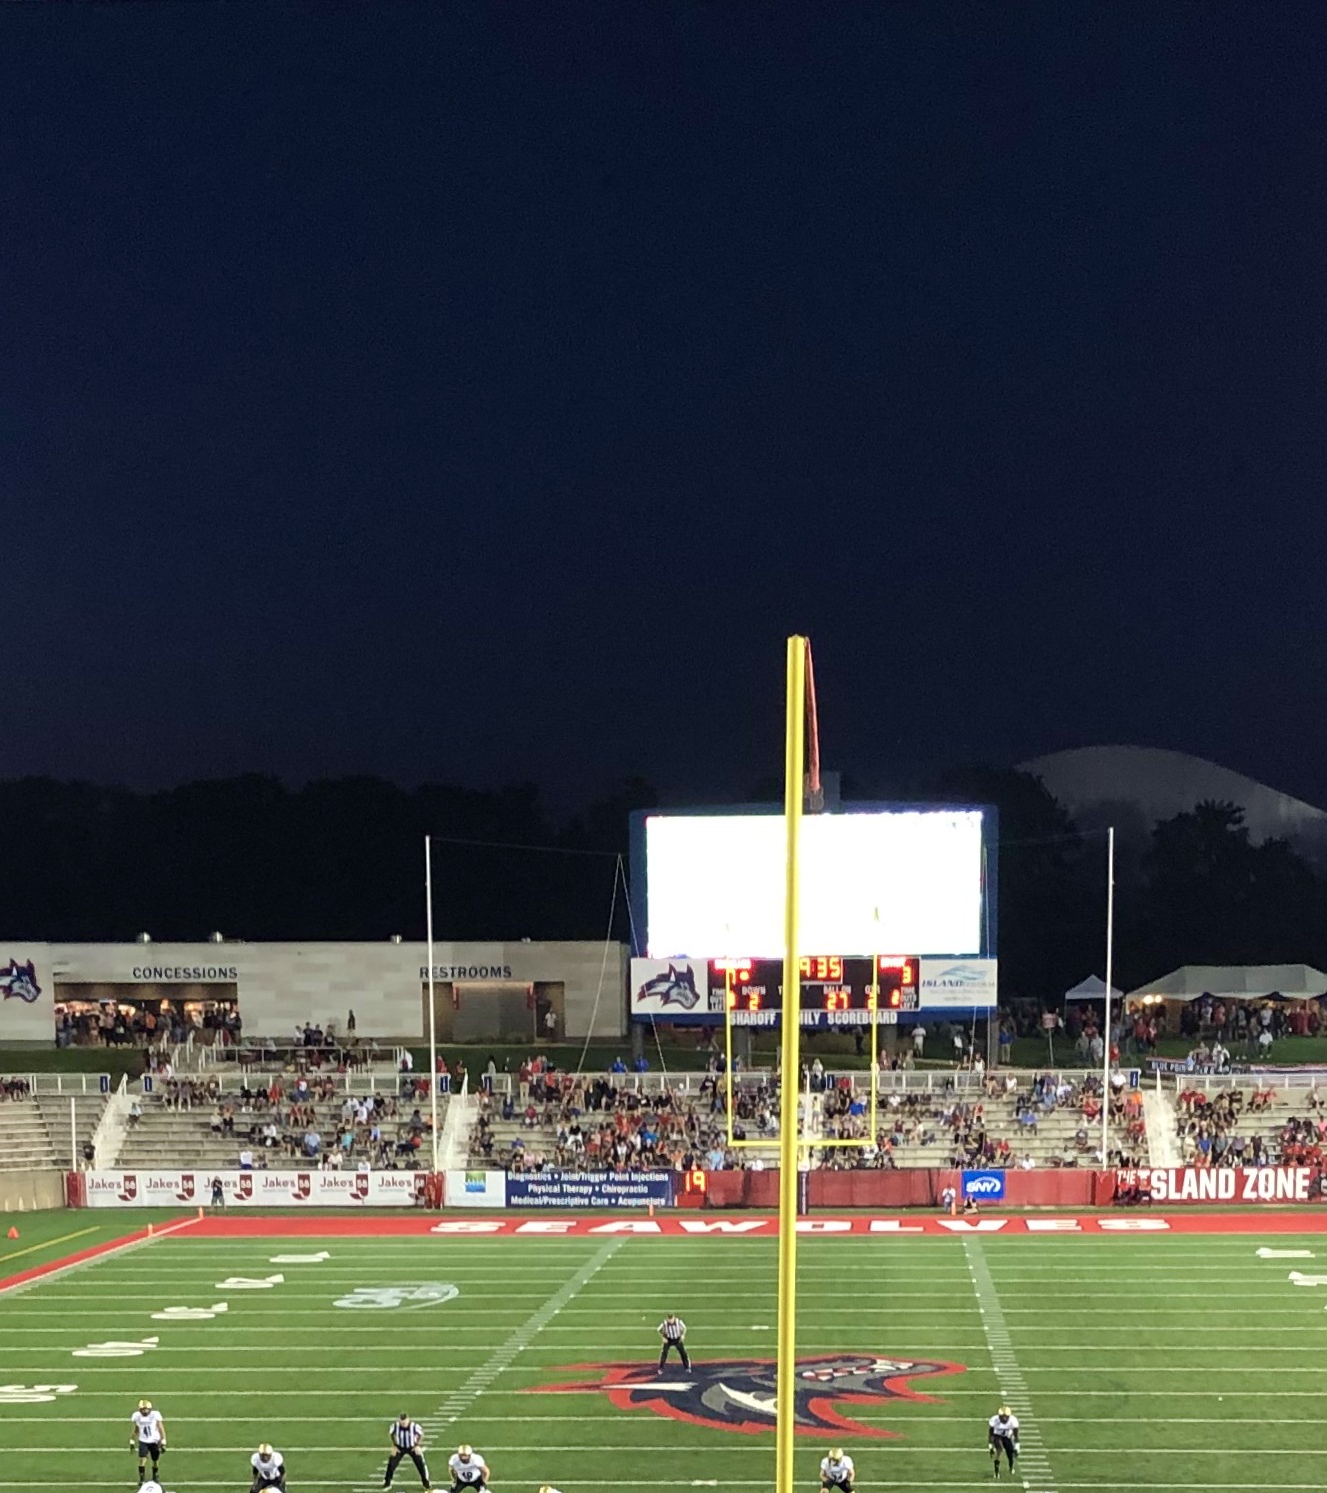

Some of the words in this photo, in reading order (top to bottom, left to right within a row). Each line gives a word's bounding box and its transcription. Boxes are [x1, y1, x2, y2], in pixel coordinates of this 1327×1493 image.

[132, 966, 239, 980] CONCESSIONS
[418, 965, 513, 979] RESTROOMS
[742, 986, 766, 995] DOWN
[826, 993, 849, 1010] 27
[827, 1011, 898, 1025] SCOREBOARD
[88, 1177, 122, 1190] Jake's
[145, 1177, 180, 1190] Jake's
[204, 1177, 238, 1189] Je's
[262, 1176, 296, 1188] Jake's
[320, 1176, 354, 1188] Jake's
[378, 1176, 412, 1188] Jake's
[507, 1172, 552, 1183] Diagnostics
[560, 1171, 607, 1183] Joint/Trigger
[609, 1172, 629, 1182] Point
[631, 1172, 669, 1183] Injections
[685, 1171, 706, 1193] 19
[1116, 1170, 1136, 1185] THE
[1242, 1168, 1311, 1199] ZONE
[528, 1183, 561, 1196] Physical
[562, 1183, 593, 1196] Therapy
[601, 1183, 649, 1195] Chiropractic
[510, 1195, 590, 1207] Medical/Prescriptive
[591, 1196, 609, 1206] Care
[617, 1195, 666, 1207] Acupuncture
[430, 1217, 1172, 1234] SEAWOLVES
[142, 1425, 152, 1438] 41
